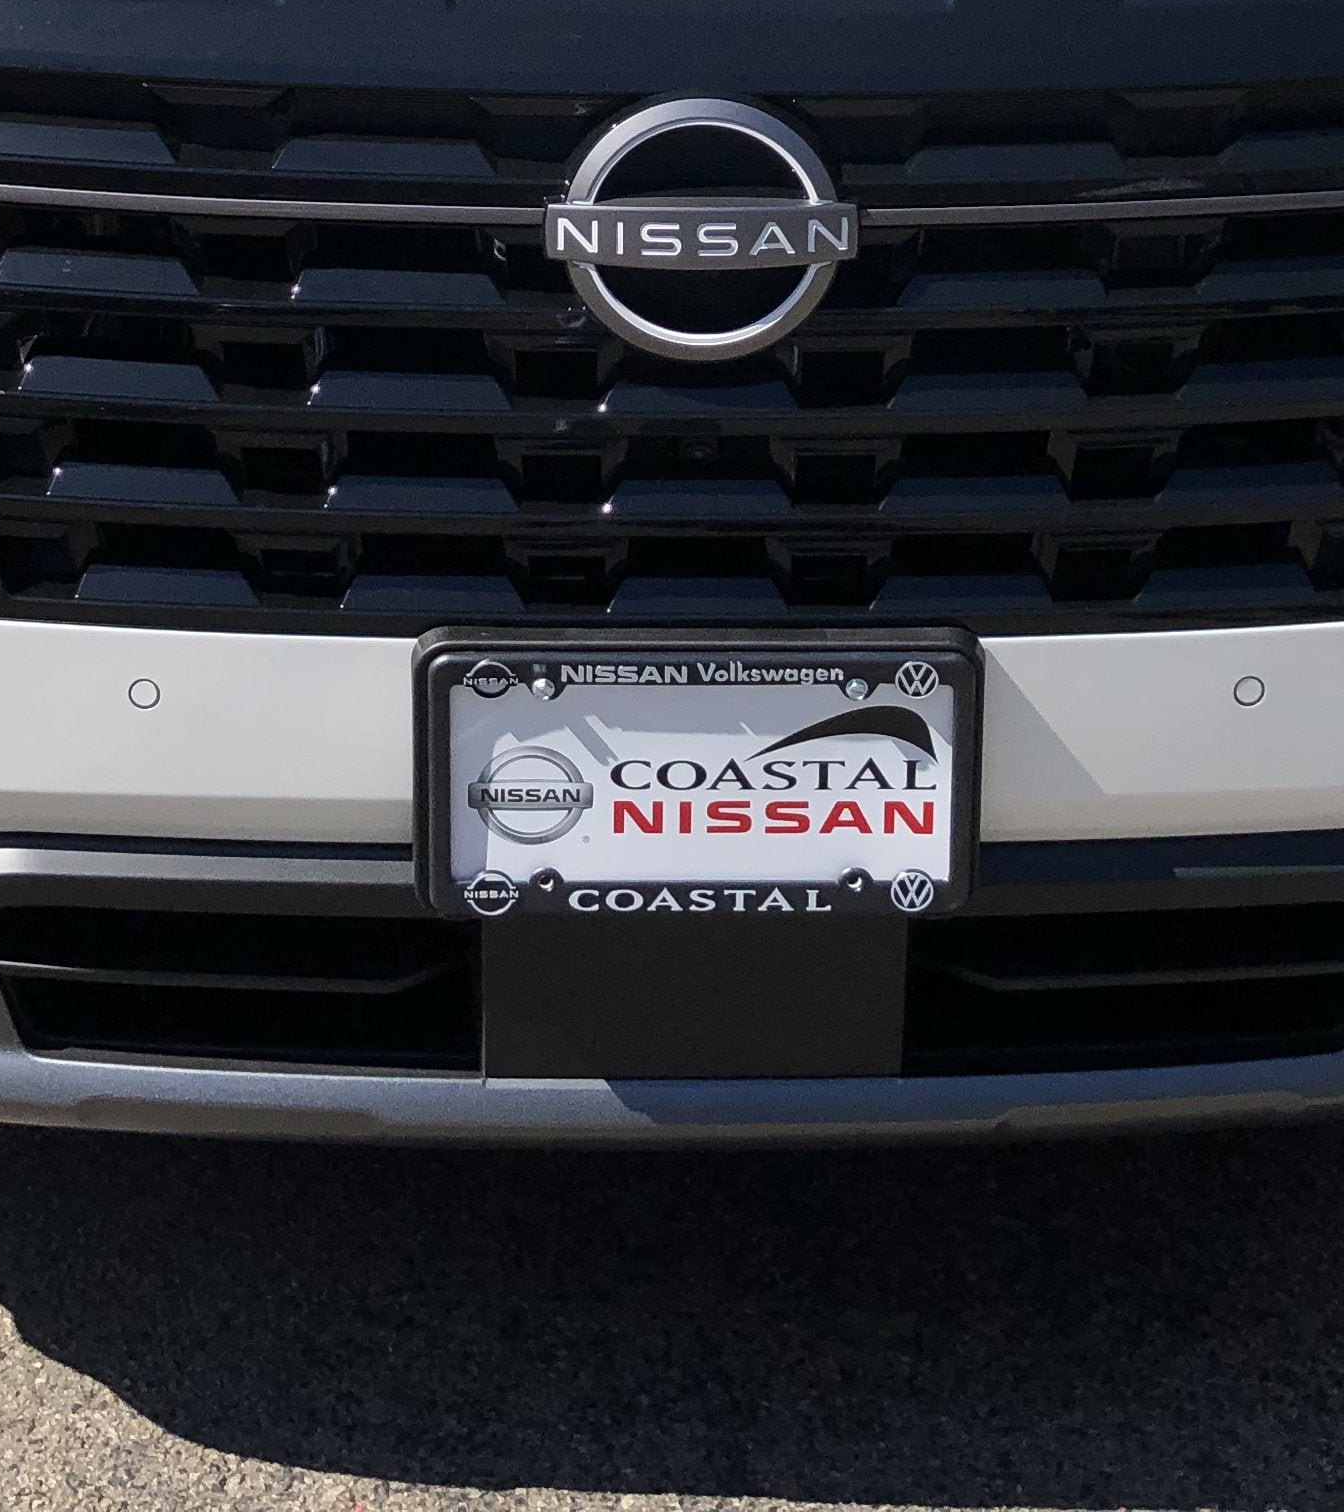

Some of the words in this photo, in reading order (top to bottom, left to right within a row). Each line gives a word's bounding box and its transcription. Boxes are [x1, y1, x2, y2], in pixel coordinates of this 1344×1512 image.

[557, 216, 849, 257] NISSAN
[463, 676, 519, 687] NISSAN
[561, 664, 688, 684] NISSAN
[697, 661, 844, 686] Volkswagen
[609, 756, 938, 791] COASTAL
[480, 788, 581, 803] NISSAN
[612, 799, 935, 835] NISSAN
[464, 889, 519, 899] NISSAN
[568, 887, 832, 912] COASTAL
